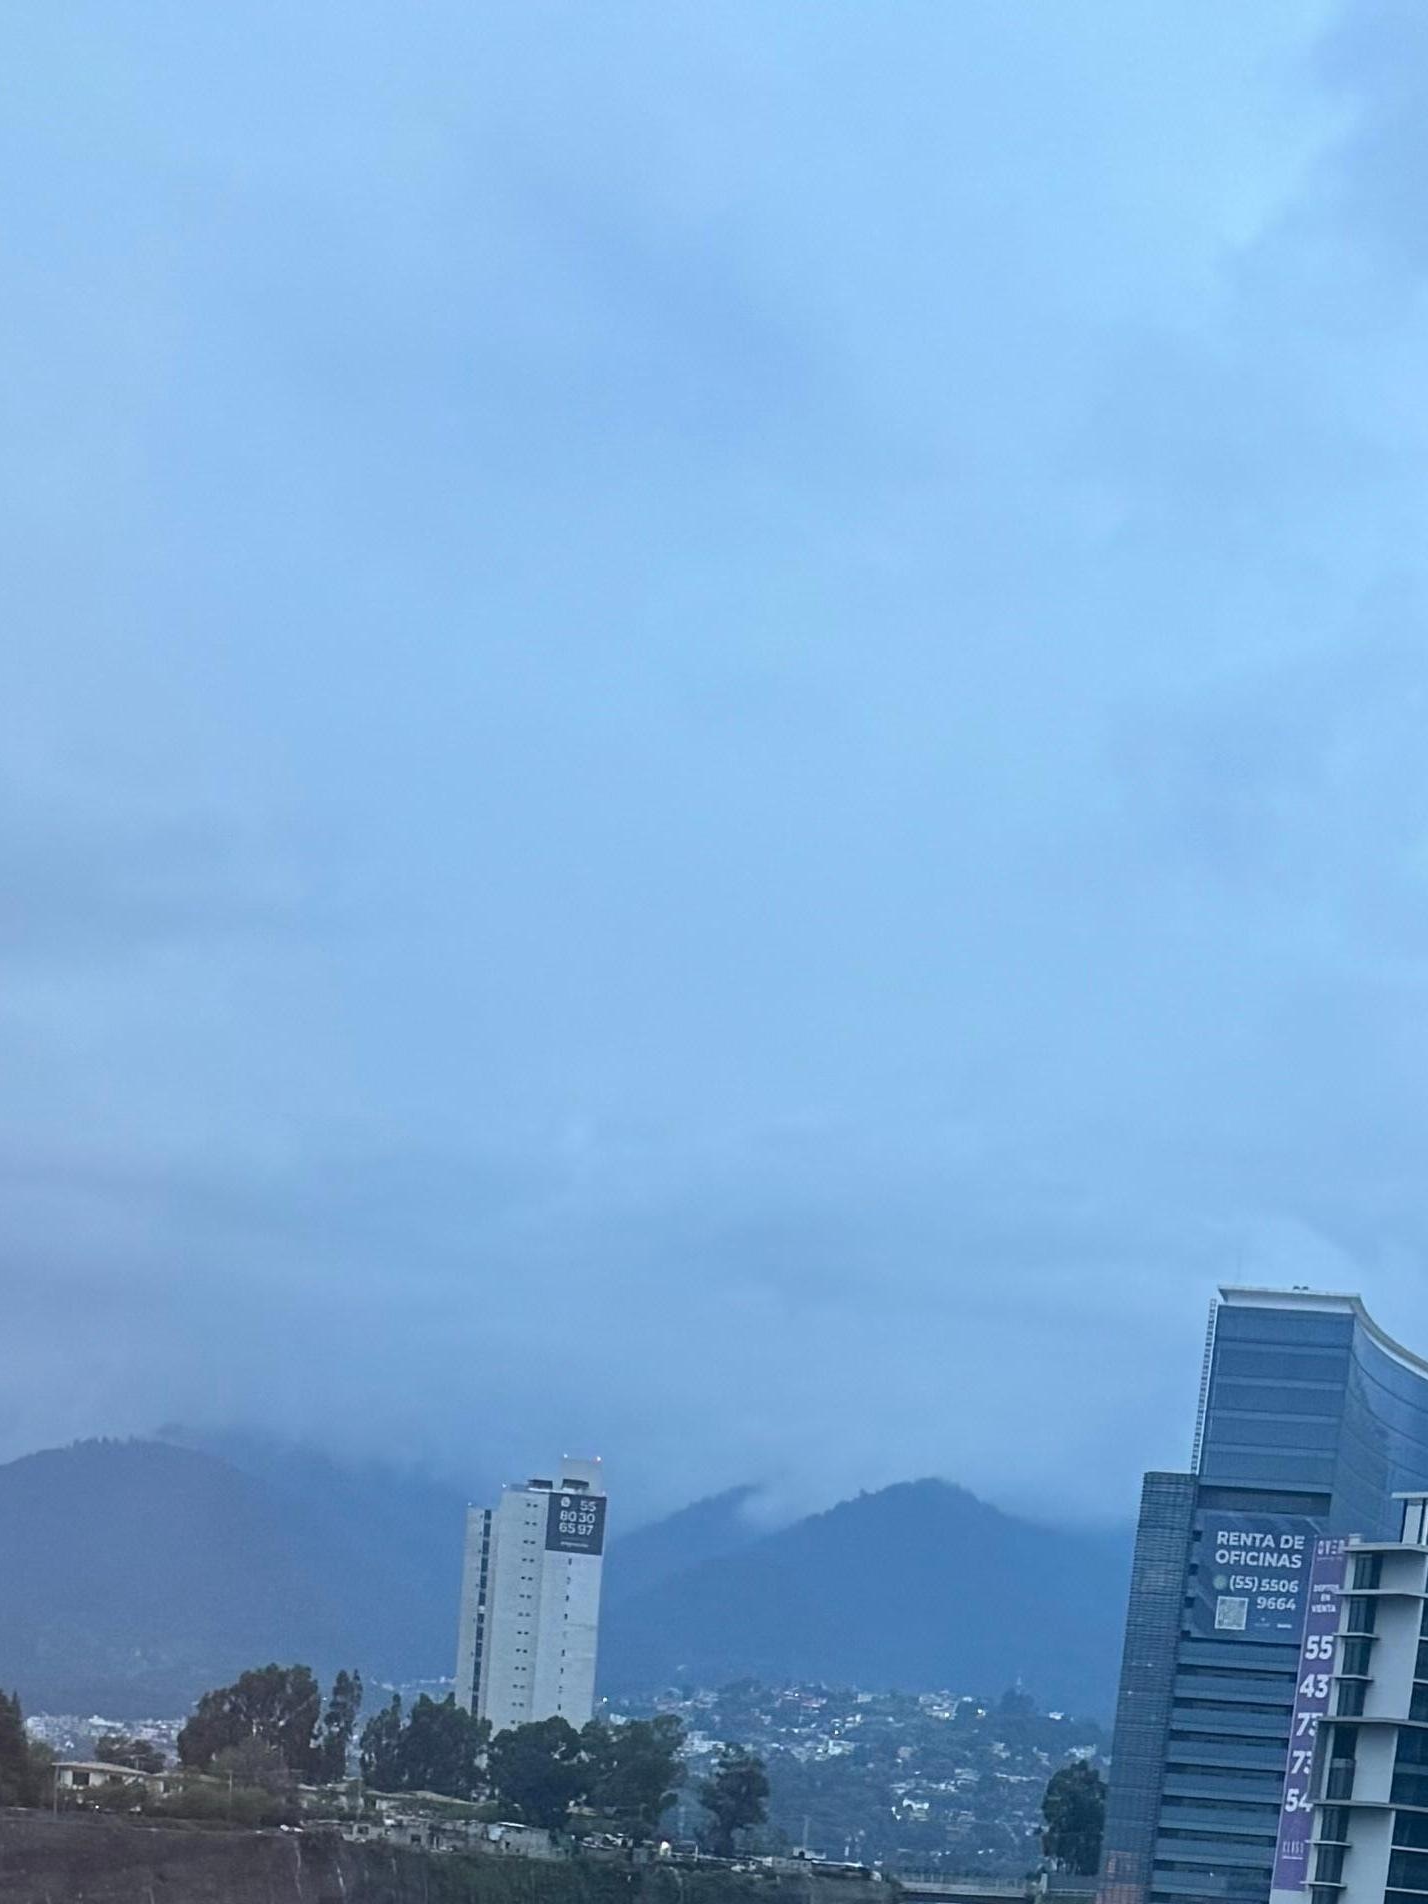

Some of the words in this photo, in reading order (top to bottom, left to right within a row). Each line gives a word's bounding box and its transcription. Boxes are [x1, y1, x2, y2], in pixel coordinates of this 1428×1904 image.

[580, 1500, 596, 1512] 55
[560, 1510, 577, 1522] 80
[578, 1512, 595, 1524] 30
[559, 1522, 576, 1534] 65
[577, 1524, 594, 1536] 97
[1217, 1531, 1275, 1548] RENTA
[1280, 1535, 1305, 1550] DE
[1215, 1550, 1303, 1568] OFICINAS
[1229, 1575, 1259, 1592] (55)
[1260, 1578, 1299, 1593] 5506
[1256, 1596, 1297, 1611] 9664
[1311, 1604, 1336, 1613] VENTA
[1305, 1635, 1334, 1660] 55
[1299, 1673, 1330, 1699] 43
